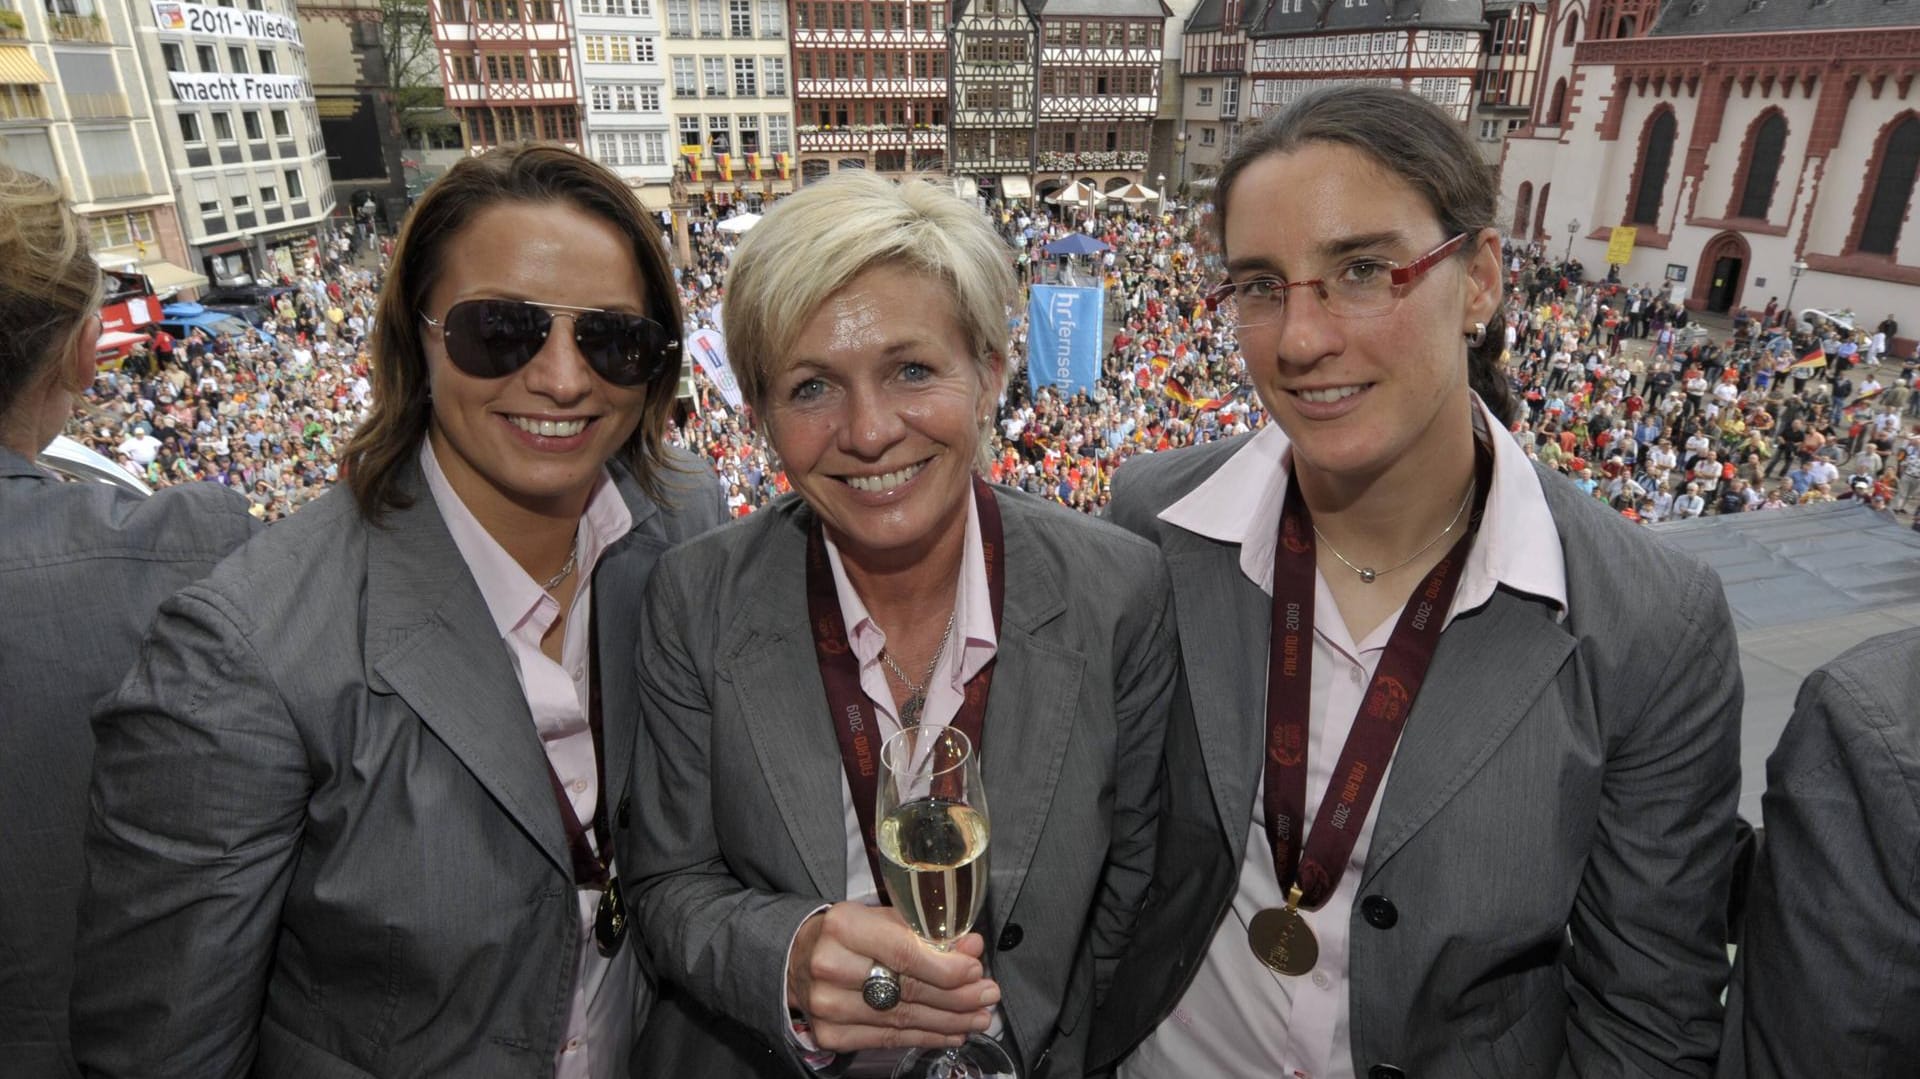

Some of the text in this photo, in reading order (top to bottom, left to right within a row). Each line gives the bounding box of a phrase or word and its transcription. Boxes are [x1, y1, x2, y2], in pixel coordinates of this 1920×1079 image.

[177, 78, 240, 100] macht
[1056, 320, 1076, 400] fernsehe
[1286, 603, 1300, 631] 2009
[1411, 601, 1433, 631] 2009
[846, 705, 863, 732] 2009
[1277, 813, 1290, 841] 2009
[1331, 803, 1351, 830] 2009
